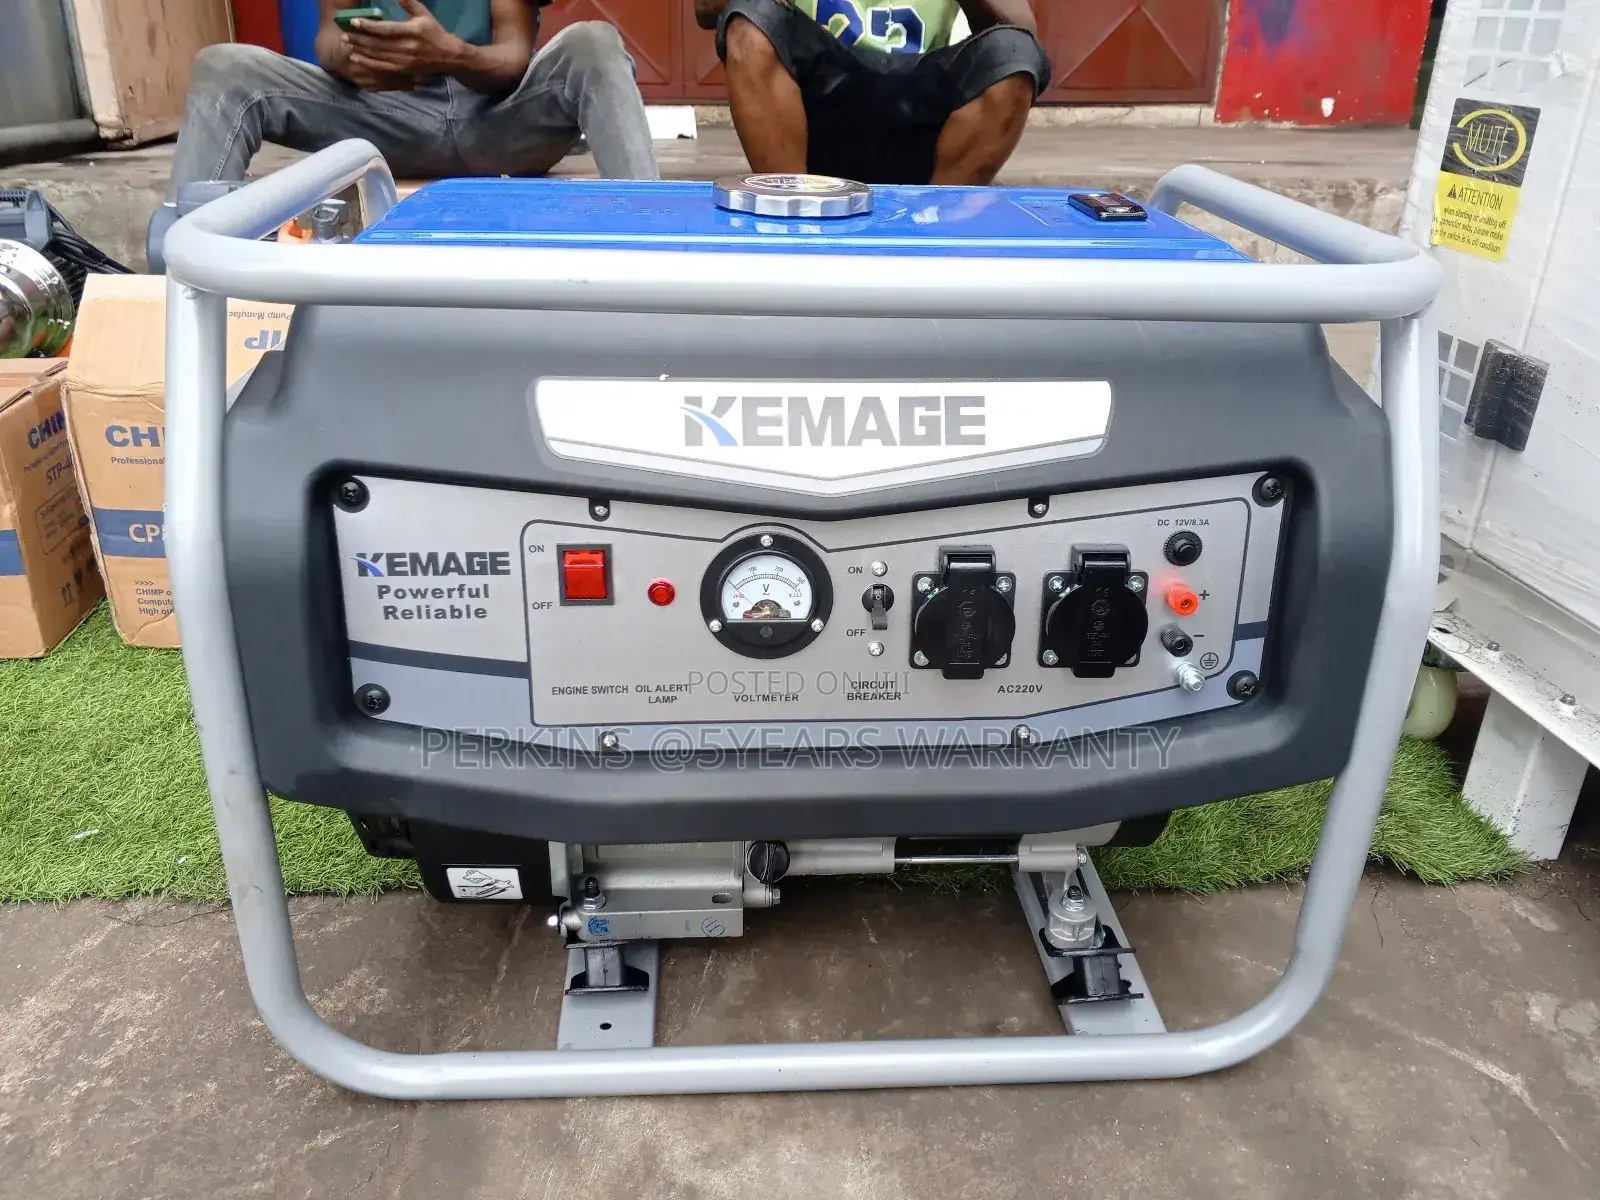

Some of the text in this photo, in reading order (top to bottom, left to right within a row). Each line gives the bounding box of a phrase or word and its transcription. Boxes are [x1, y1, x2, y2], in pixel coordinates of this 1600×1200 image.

[1465, 121, 1515, 159] MUTE
[1457, 186, 1504, 211] ATTENTION
[680, 396, 986, 447] KEMAGE
[105, 424, 166, 448] CH
[1157, 518, 1210, 527] DC 12V/8.3A
[128, 523, 165, 543] CP
[528, 544, 545, 554] ON
[350, 551, 512, 578] KEMAGE
[847, 566, 863, 575] ON
[136, 588, 164, 597] CHIMP
[377, 583, 490, 600] Powerful
[532, 601, 554, 611] OFF
[139, 606, 160, 617] High
[383, 604, 488, 621] Reliable
[846, 628, 867, 637] OFF
[551, 684, 629, 696] ENGINE SWITCH
[635, 683, 690, 693] OIL ALERT
[850, 680, 896, 690] CIRCUIT
[997, 683, 1044, 694] AC220V
[648, 695, 678, 704] LAMP
[733, 693, 800, 703] VOLTMETER
[846, 691, 902, 701] BREAKER
